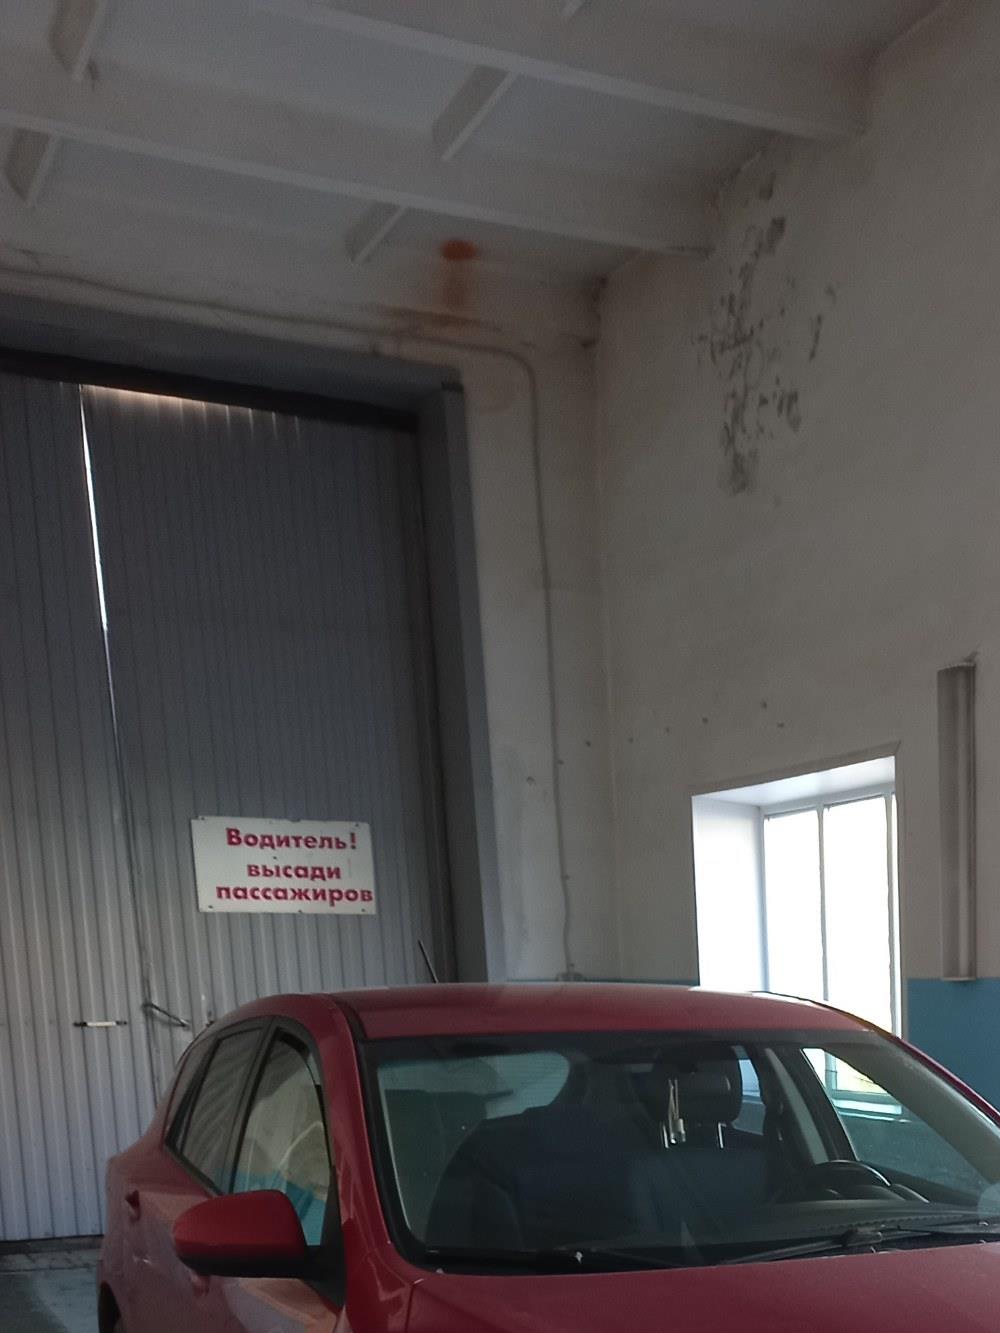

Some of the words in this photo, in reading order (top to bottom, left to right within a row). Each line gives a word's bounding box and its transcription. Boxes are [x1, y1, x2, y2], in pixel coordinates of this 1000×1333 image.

[225, 827, 357, 850] Водитель!
[247, 864, 341, 881] высади
[216, 885, 373, 907] пассажиров
